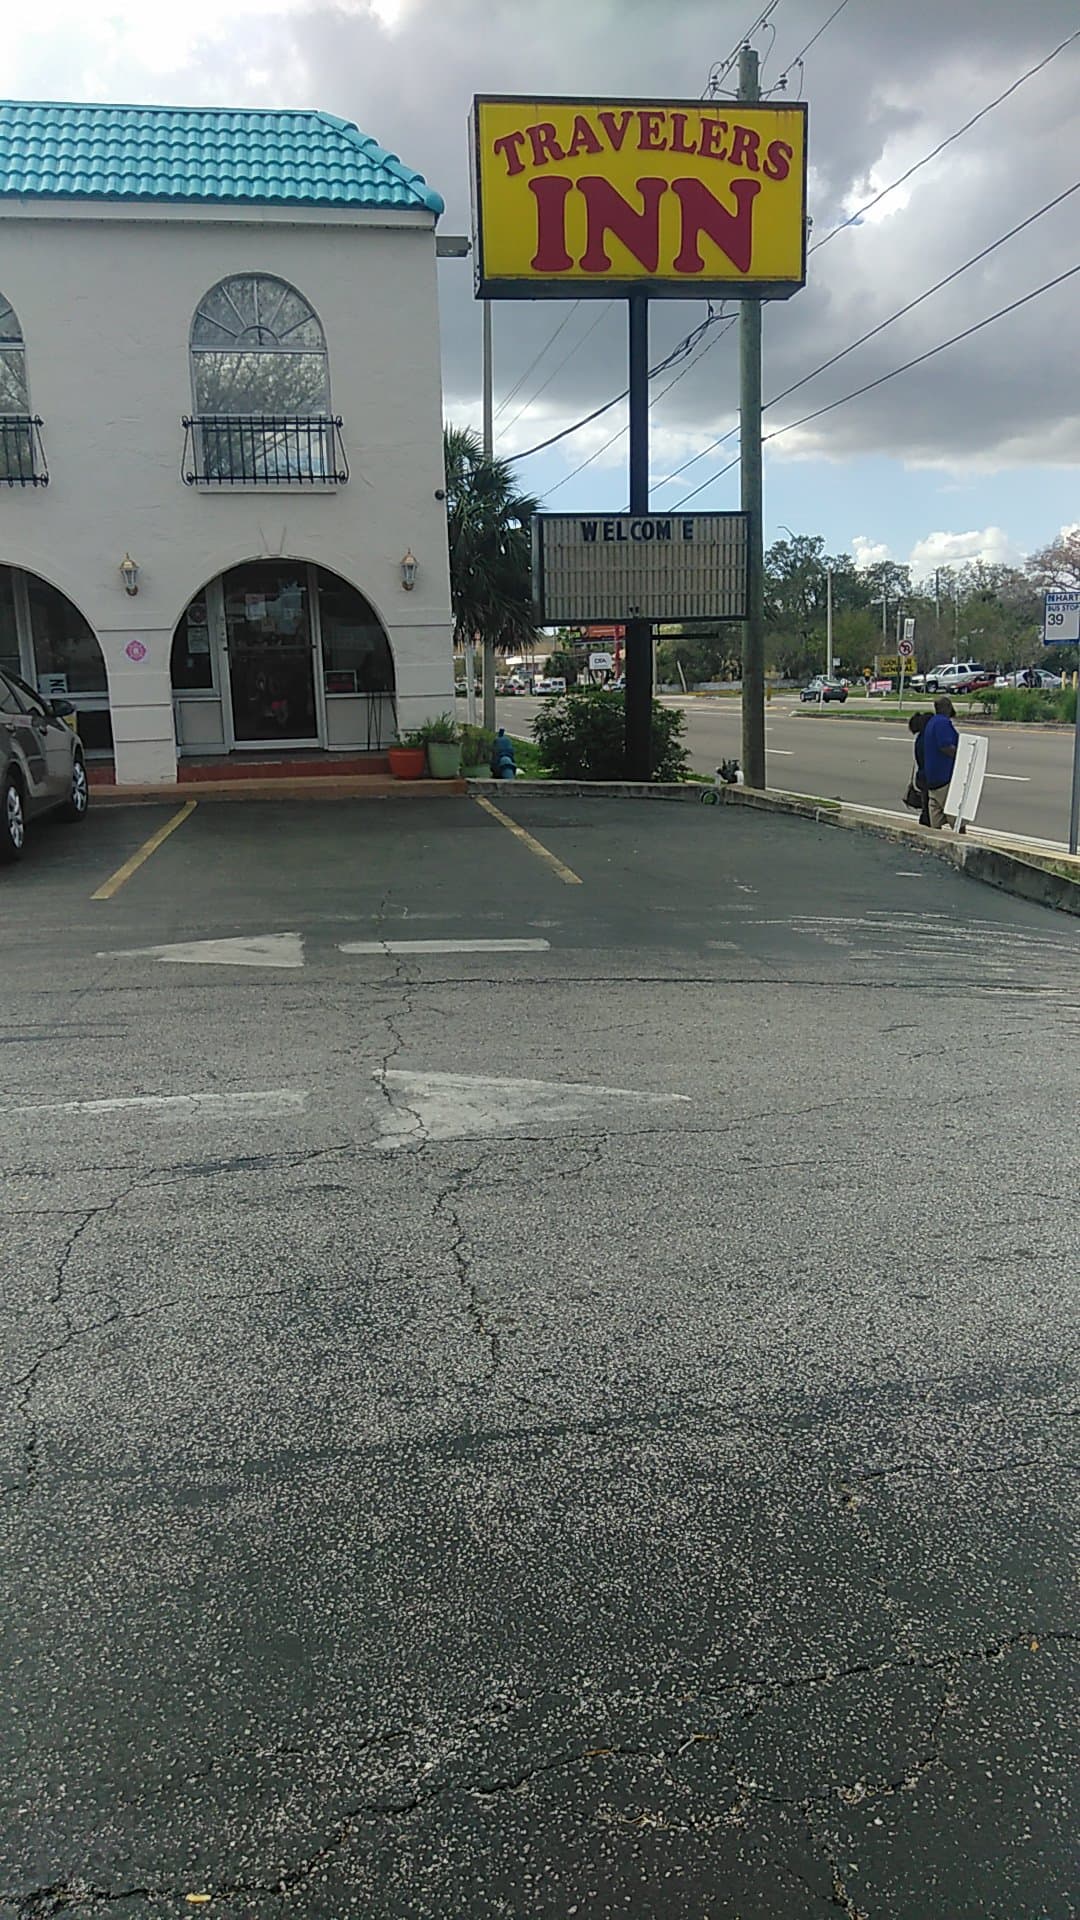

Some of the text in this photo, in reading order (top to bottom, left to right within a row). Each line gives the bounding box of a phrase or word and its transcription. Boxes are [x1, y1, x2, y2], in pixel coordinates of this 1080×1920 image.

[493, 111, 793, 181] TRAVELERS
[528, 175, 761, 273] INN
[581, 520, 694, 541] WELCOME
[1056, 593, 1079, 601] HART
[1048, 603, 1079, 612] BUS STOP
[1047, 613, 1064, 626] 39
